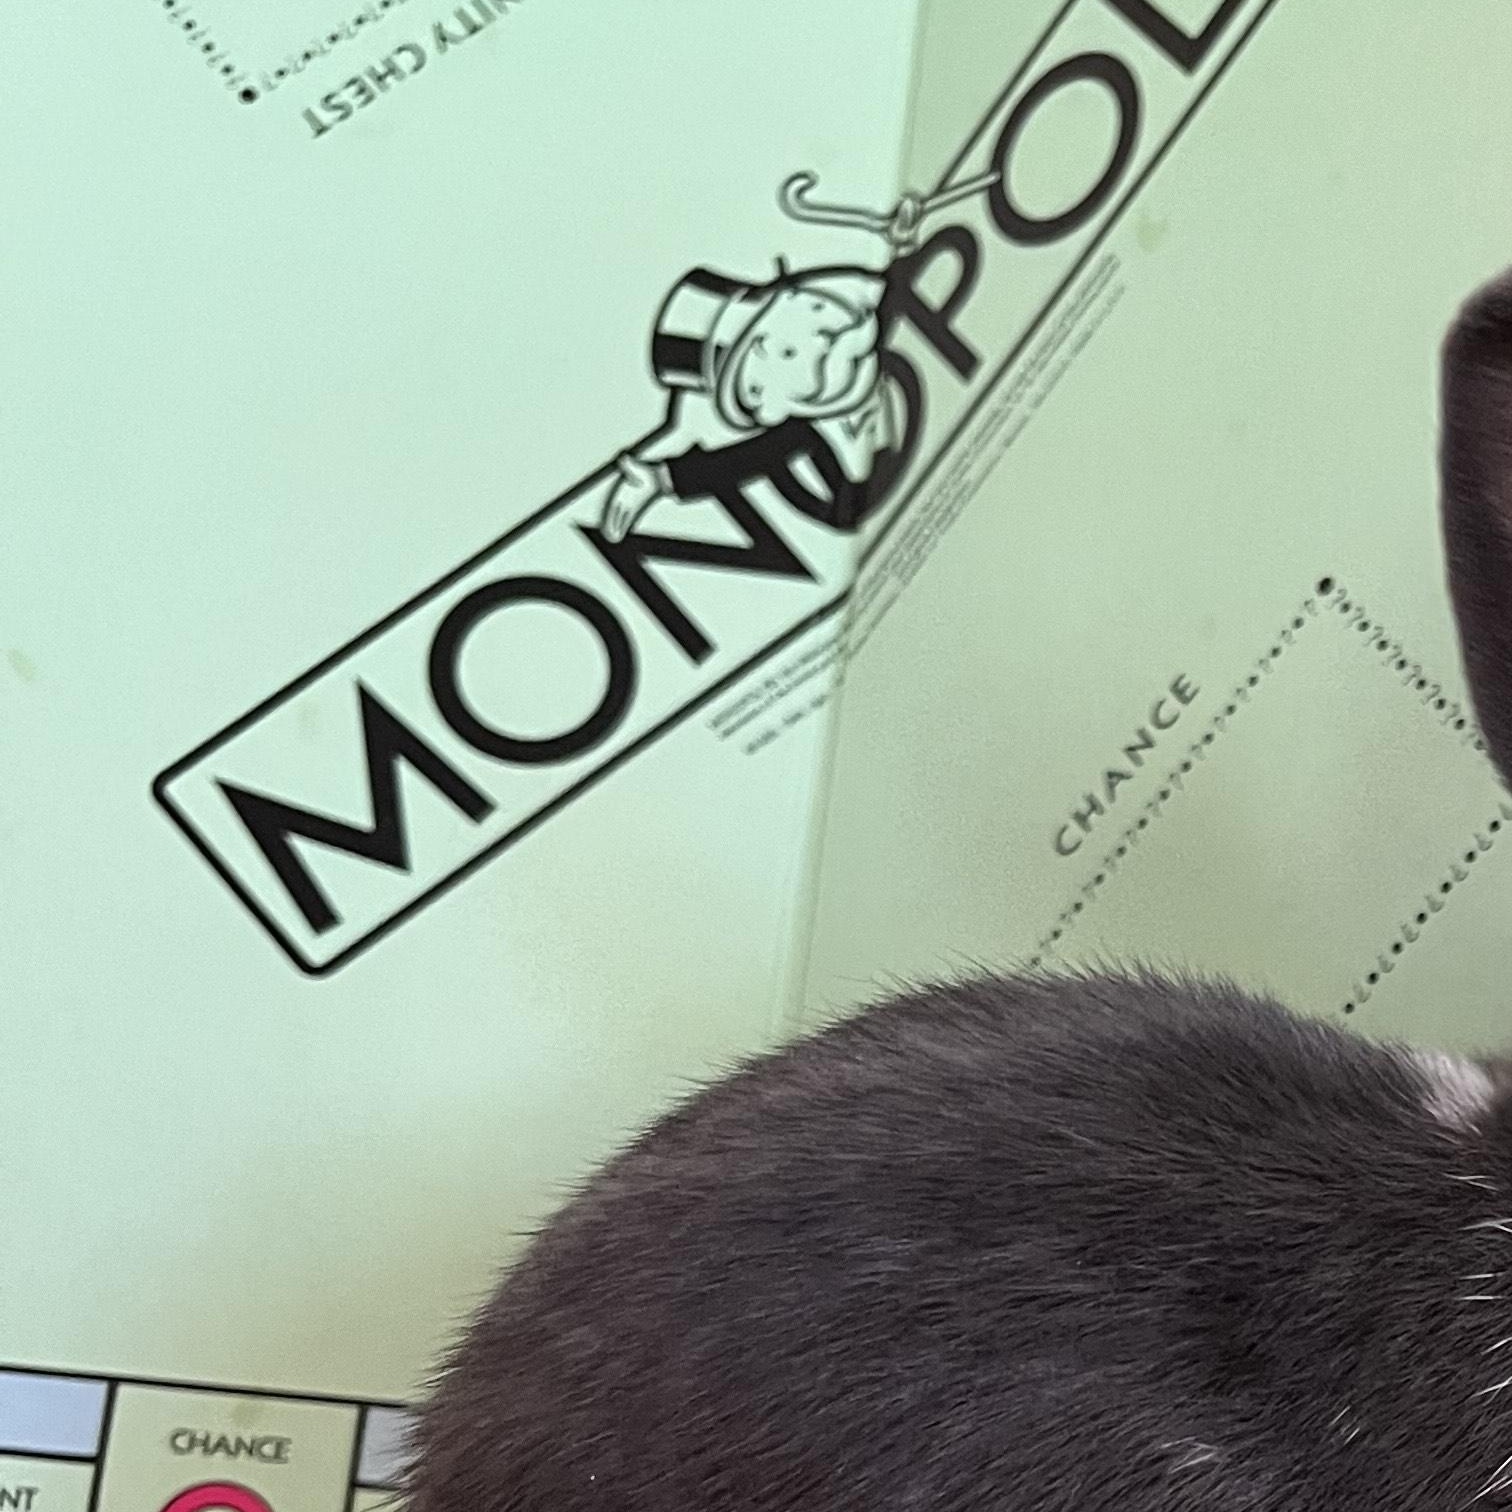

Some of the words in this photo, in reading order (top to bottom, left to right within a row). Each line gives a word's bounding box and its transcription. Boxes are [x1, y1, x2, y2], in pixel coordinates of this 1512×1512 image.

[302, 43, 427, 139] CHEST
[1055, 673, 1200, 856] CHANCE
[170, 1427, 292, 1464] CHANCE
